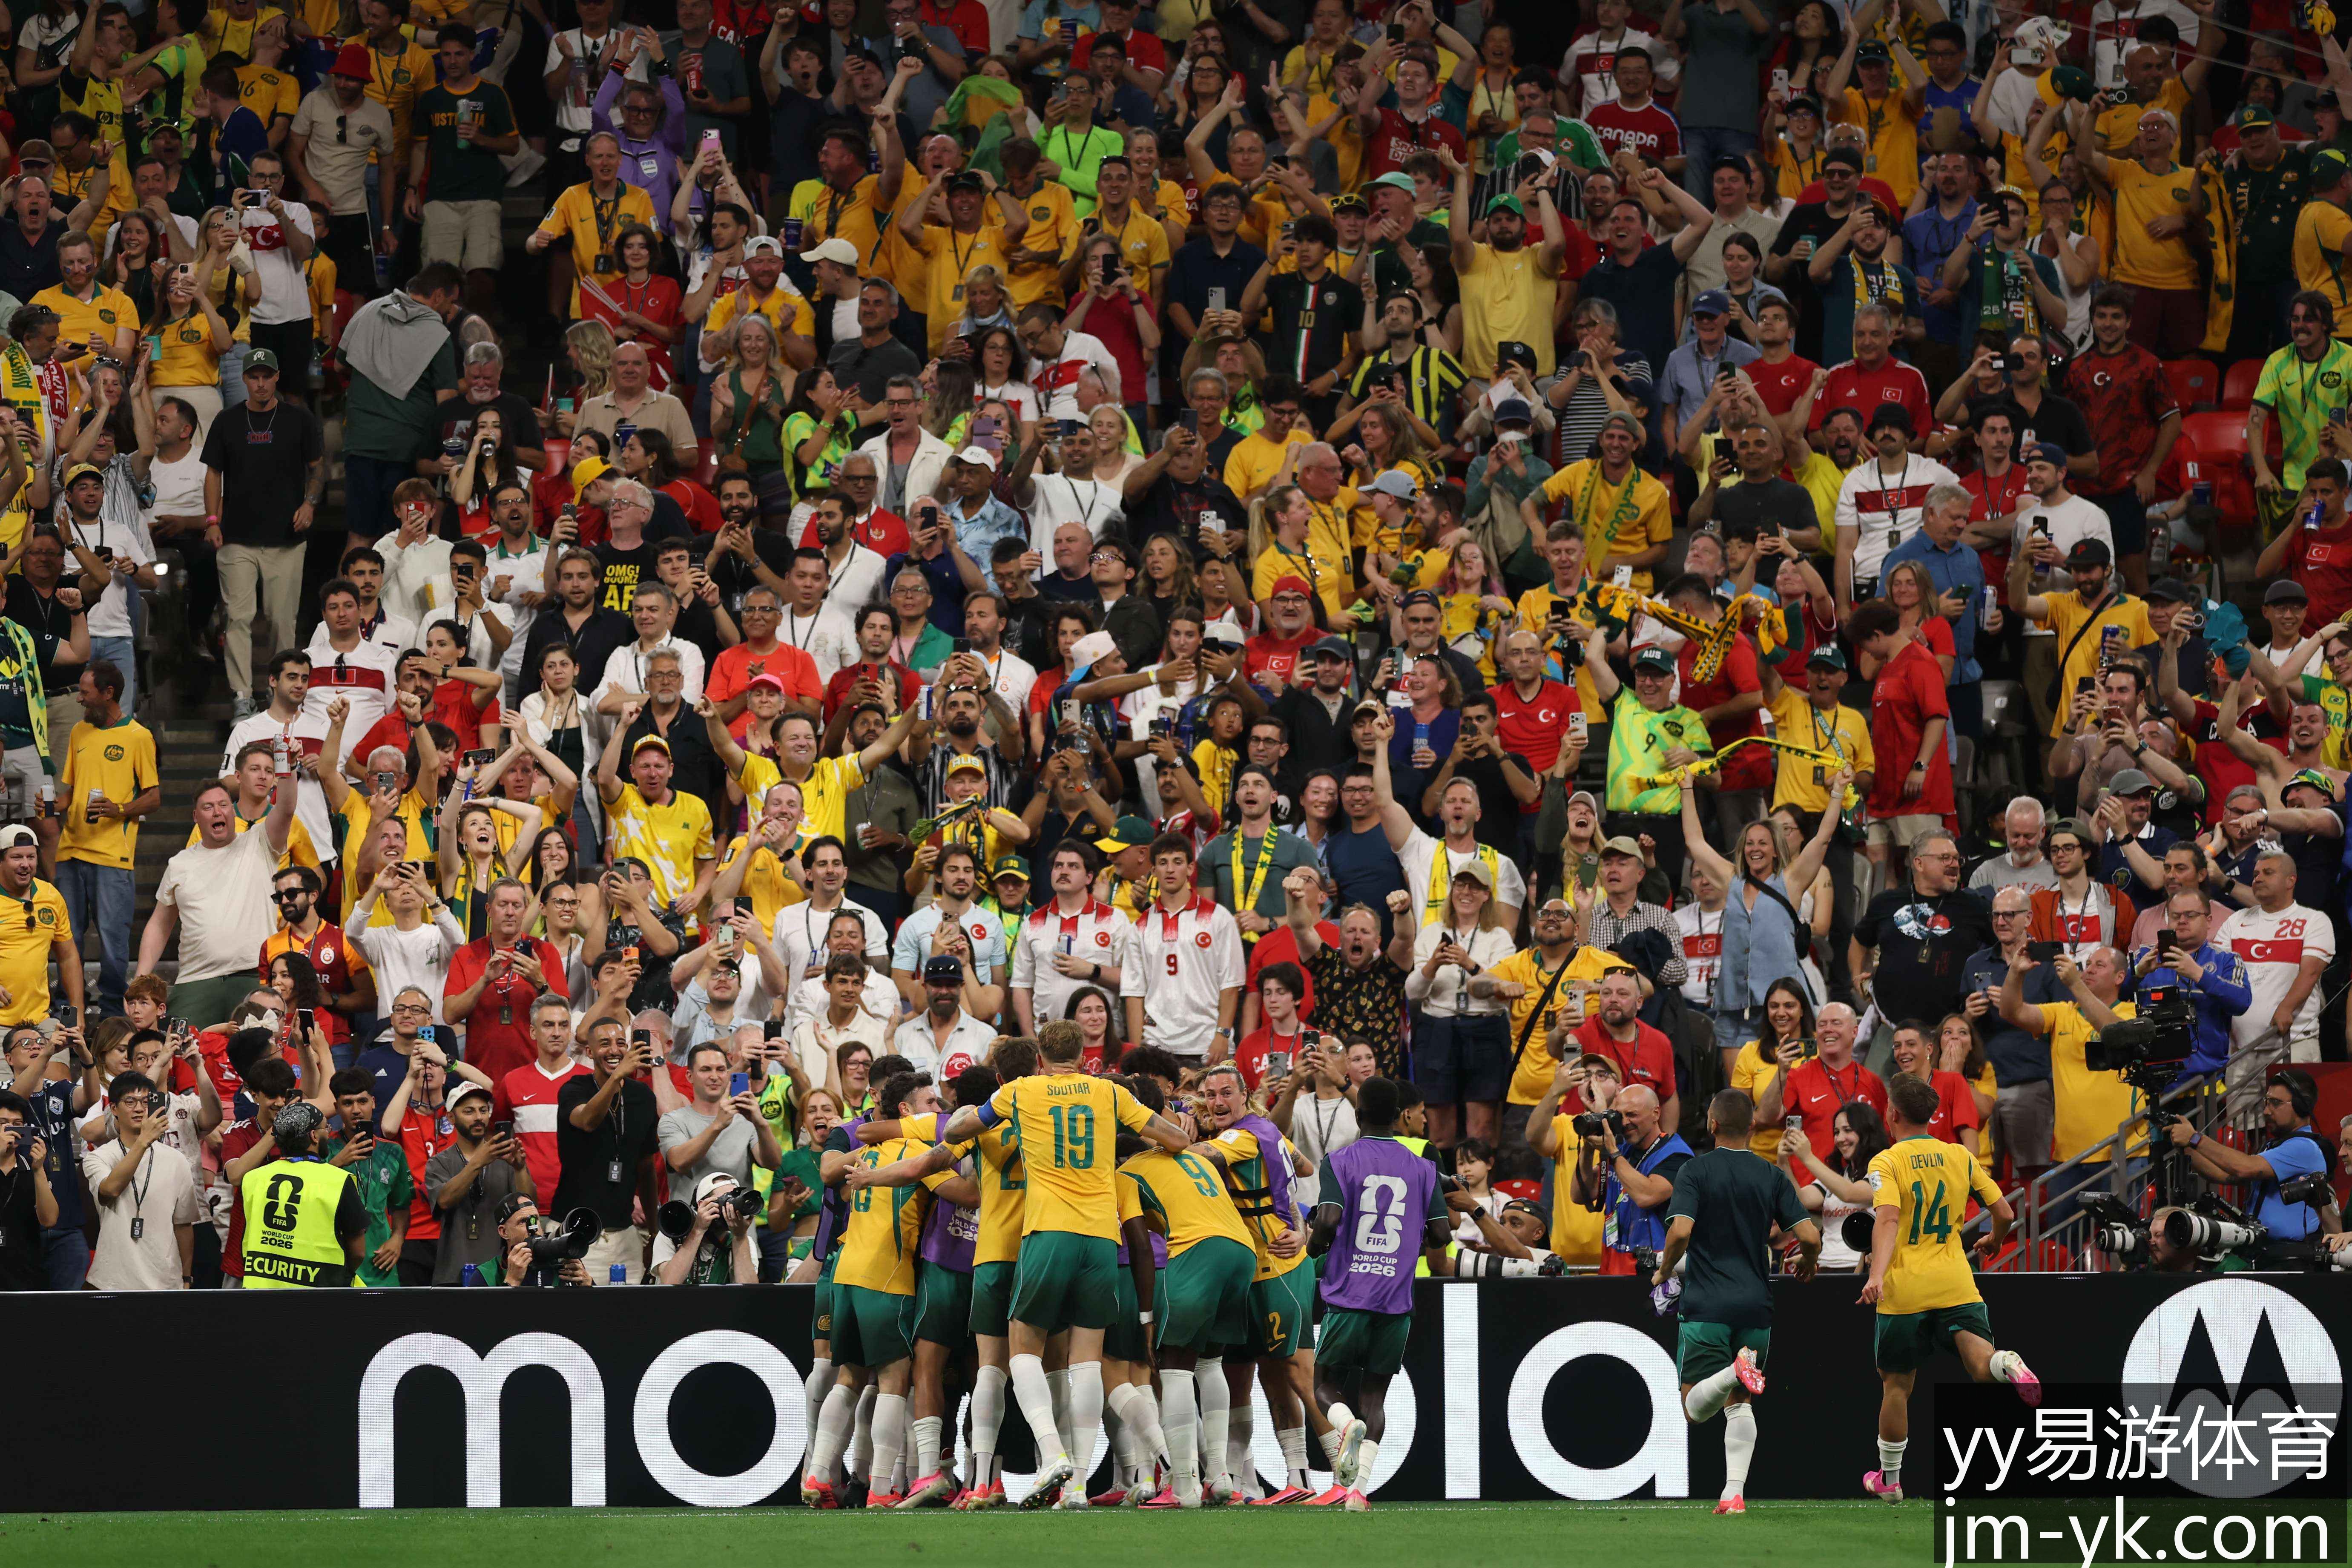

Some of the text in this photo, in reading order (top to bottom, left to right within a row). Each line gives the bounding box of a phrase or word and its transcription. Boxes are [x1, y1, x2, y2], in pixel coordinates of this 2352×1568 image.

[1596, 126, 1658, 148] CANADA
[1298, 310, 1316, 328] 10
[606, 565, 640, 578] OMG!
[1642, 649, 1662, 660] AUS
[1814, 646, 1832, 657] AUS
[1643, 733, 1657, 753] 9
[2274, 918, 2307, 938] 28
[1166, 954, 1177, 976] 9
[1047, 1082, 1090, 1096] SOUTTAR
[1048, 1105, 1095, 1169] 19
[1910, 1153, 1944, 1169] DEVLIN
[1173, 1154, 1218, 1198] 9
[1908, 1180, 1952, 1245] 14
[272, 1218, 287, 1227] FIFA
[261, 1230, 282, 1239] WORLD
[1366, 1236, 1387, 1246] FIFA
[260, 1236, 293, 1249] 2026
[1352, 1254, 1398, 1265] WORLD CUP
[244, 1256, 321, 1283] ECURITY
[1351, 1262, 1396, 1277] 2026
